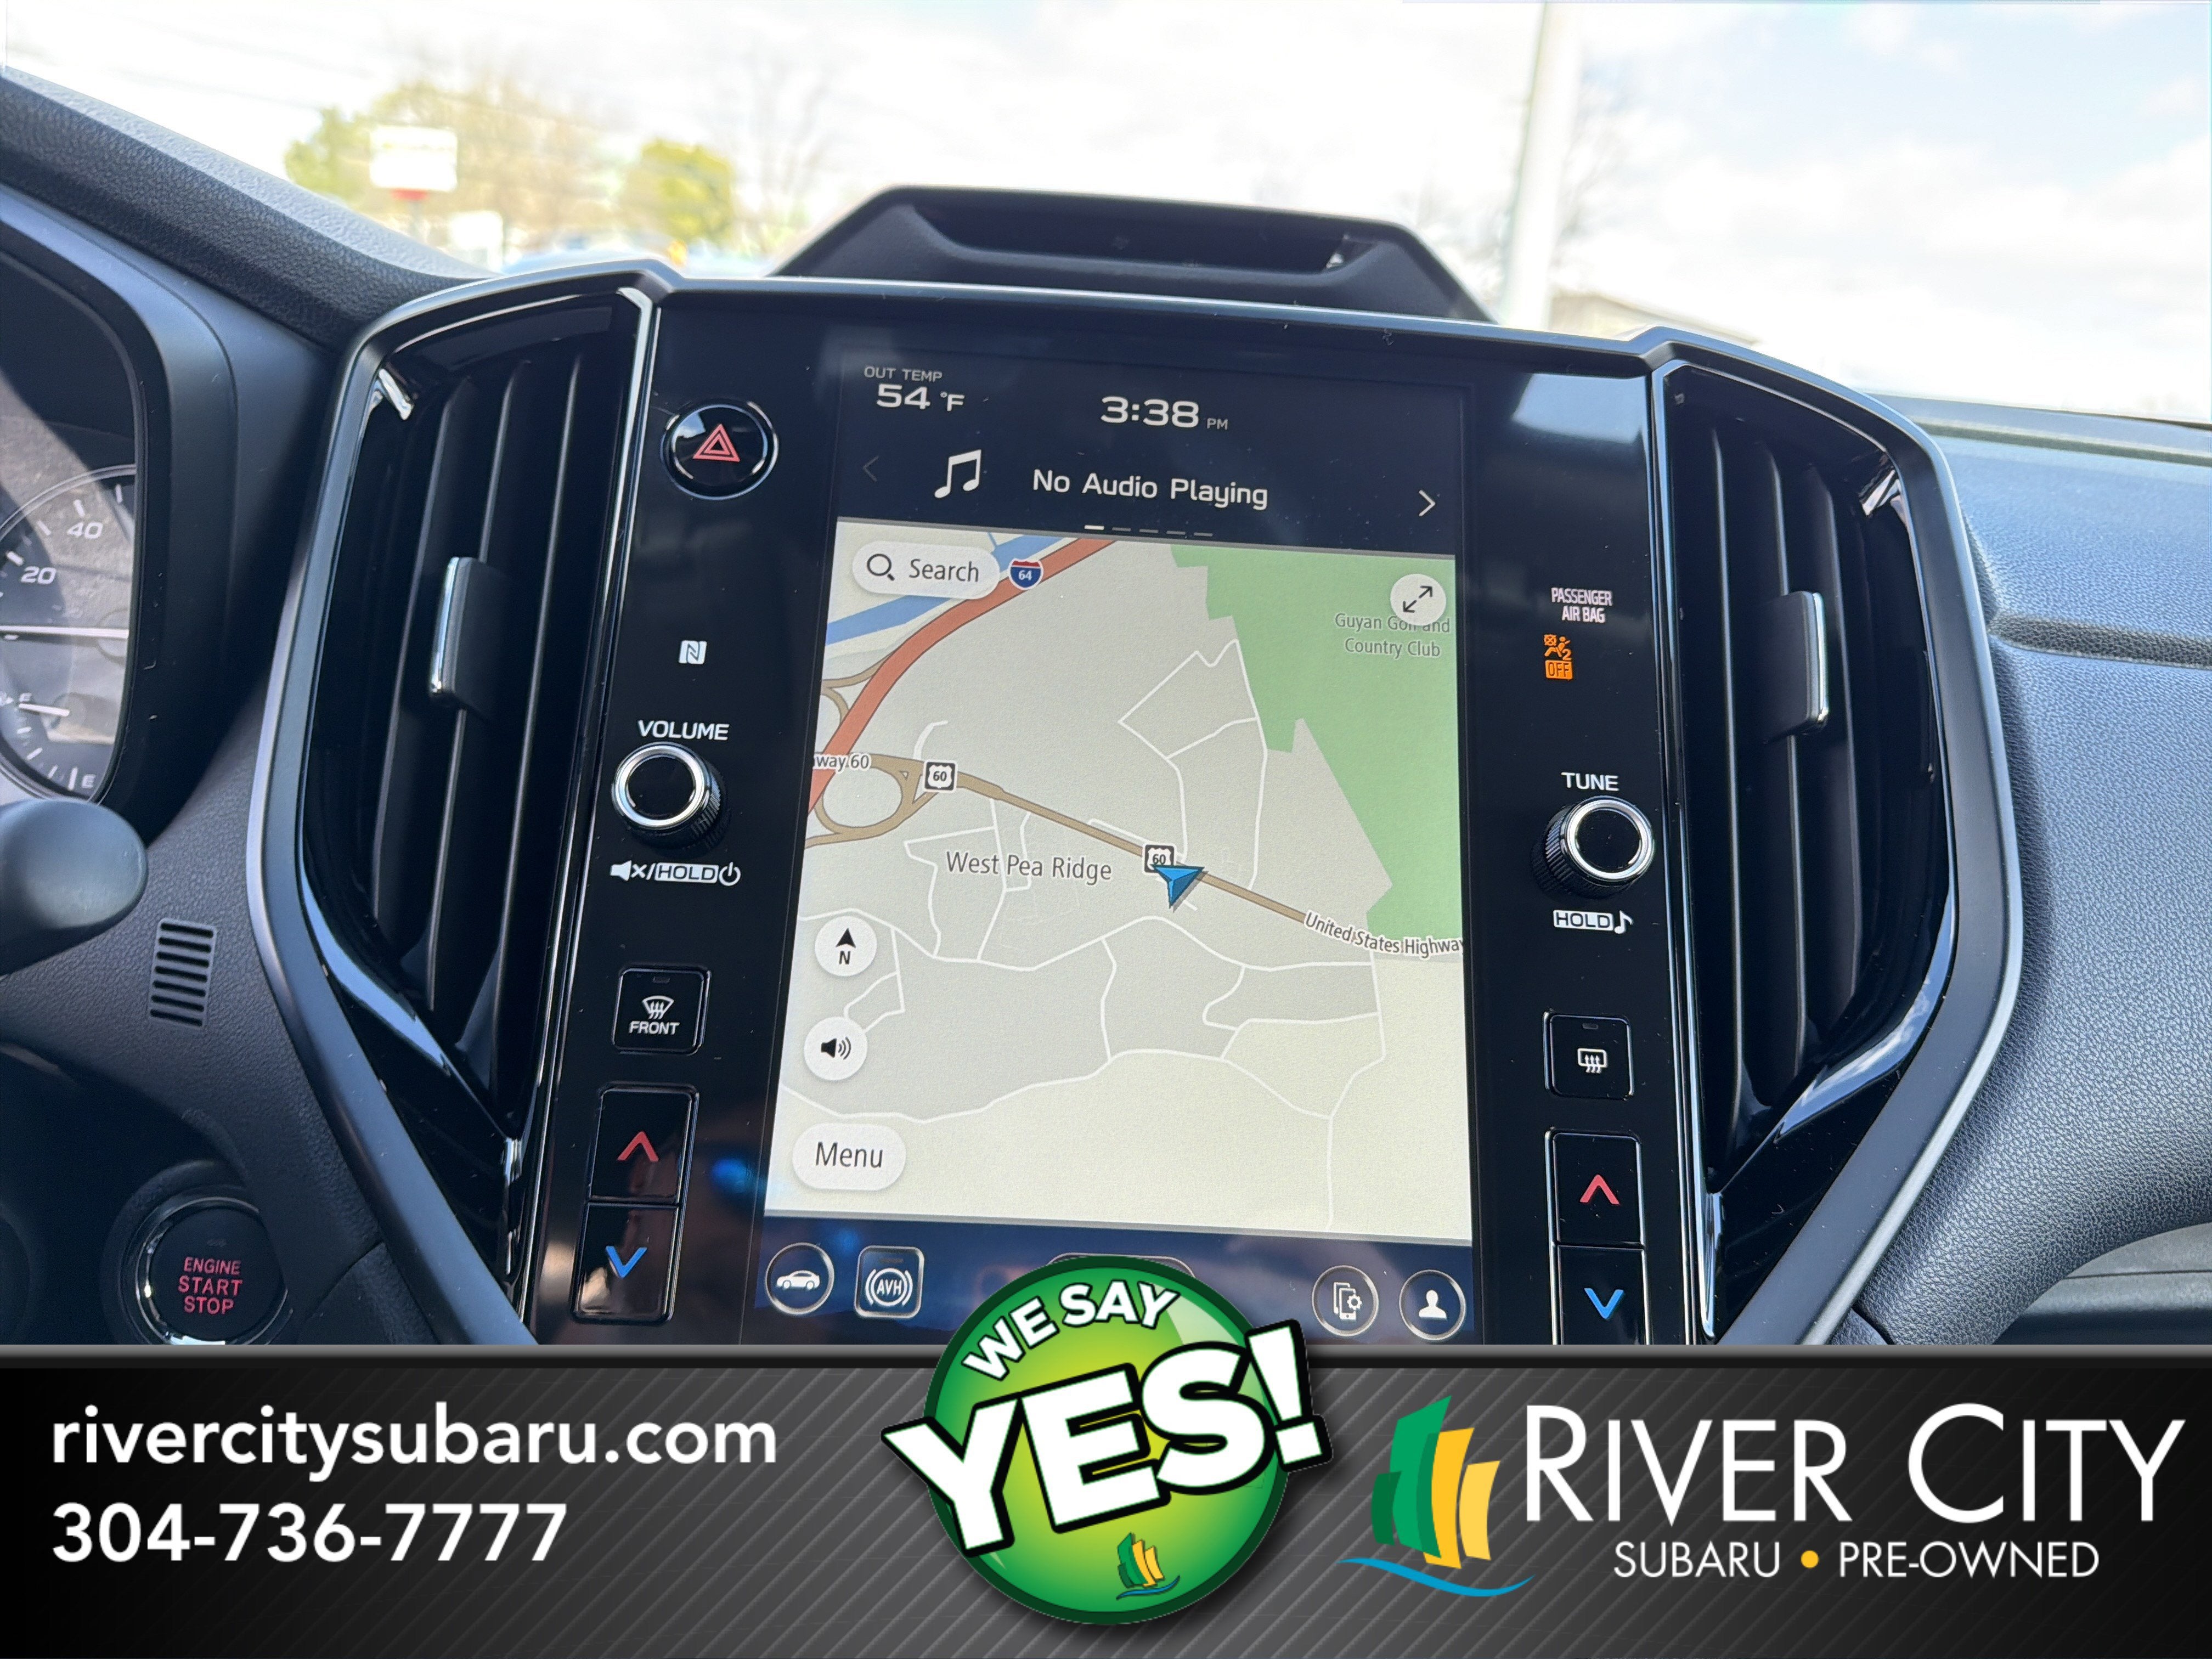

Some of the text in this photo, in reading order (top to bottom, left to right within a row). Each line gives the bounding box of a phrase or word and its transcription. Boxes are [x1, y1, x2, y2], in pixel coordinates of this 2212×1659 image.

[864, 366, 943, 382] OUT TEMP
[877, 383, 930, 409] 54
[1101, 396, 1228, 430] 3:38 PM
[1033, 469, 1268, 510] No Audio Playing
[67, 522, 103, 539] 40
[20, 566, 57, 584] 20
[909, 558, 979, 583] Search
[1018, 570, 1032, 580] 64
[1551, 588, 1612, 606] PASSENGER
[1335, 613, 1381, 632] Guyan
[1562, 606, 1606, 623] AIR BAG
[1345, 638, 1441, 659] Country Club
[1547, 661, 1570, 678] OFF
[637, 720, 730, 741] VOLUME
[851, 754, 870, 769] 60
[82, 774, 96, 788] E
[933, 771, 947, 782] 60
[1561, 772, 1620, 791] TUNE
[946, 851, 1112, 886] West Pea Ridge
[1152, 854, 1166, 865] 60
[1556, 911, 1611, 928] HOLD
[1306, 912, 1353, 942] United
[1355, 931, 1400, 953] States
[838, 950, 851, 966] N
[629, 1021, 680, 1035] FRONT
[815, 1142, 883, 1169] Menu
[183, 1256, 241, 1276] ENGINE
[178, 1275, 243, 1296] START
[876, 1278, 901, 1297] AVH
[183, 1295, 235, 1314] STOP
